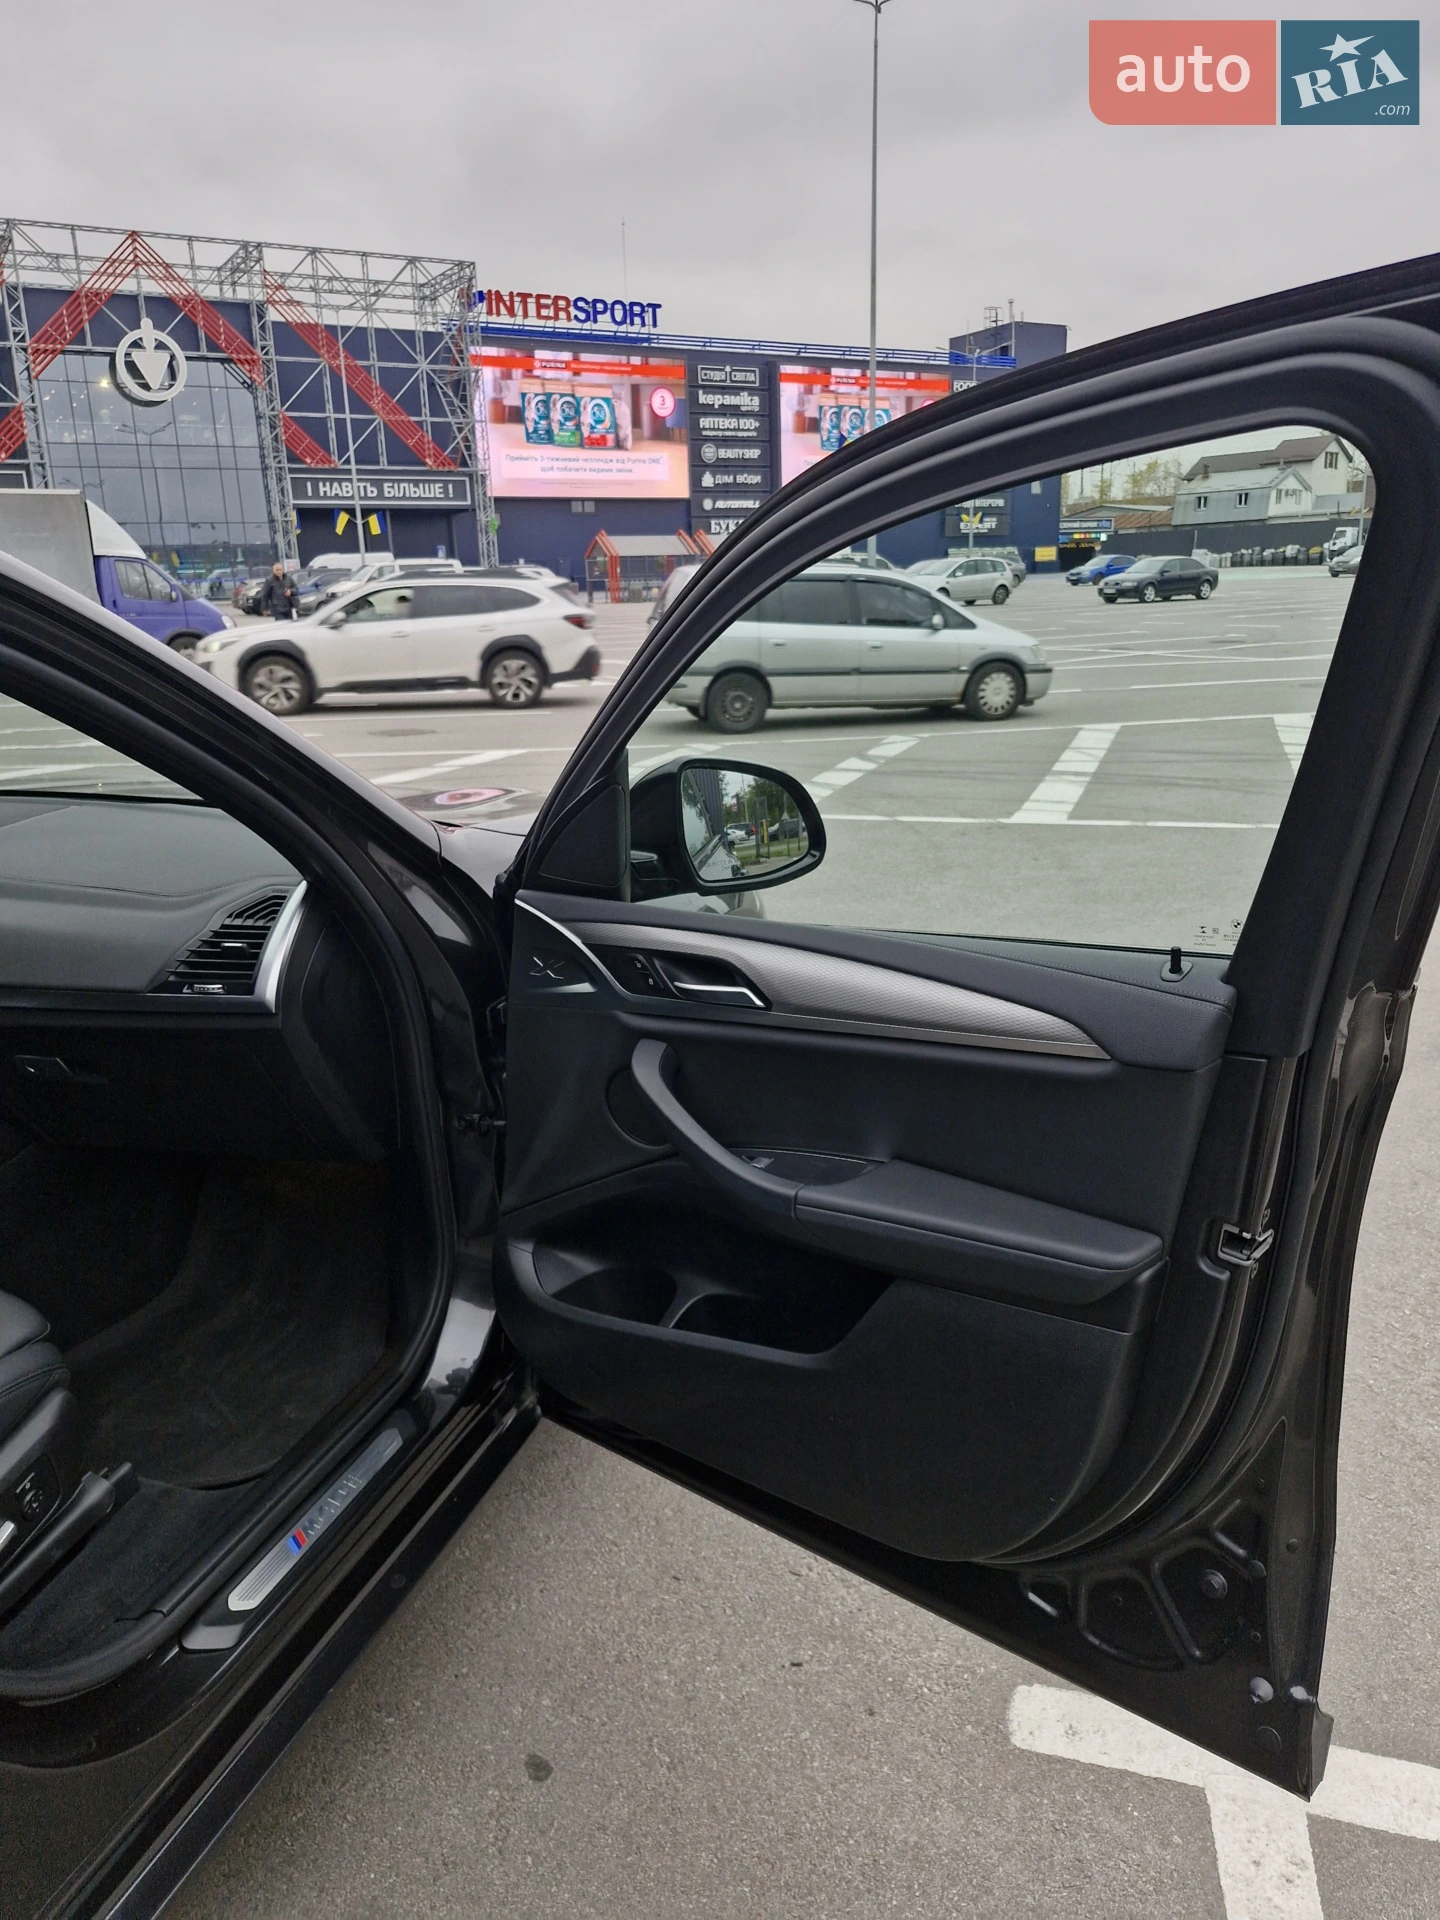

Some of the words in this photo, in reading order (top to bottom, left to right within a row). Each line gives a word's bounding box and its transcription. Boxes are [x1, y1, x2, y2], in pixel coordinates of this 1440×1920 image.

[486, 289, 662, 328] INTERSPORT
[699, 417, 738, 429] АПТЕКА
[739, 418, 761, 430] 100+
[715, 474, 734, 484] ДІМ
[318, 482, 378, 498] НАВТЬ
[383, 482, 445, 498] БІЛЬШЕ
[710, 520, 744, 535] БУК
